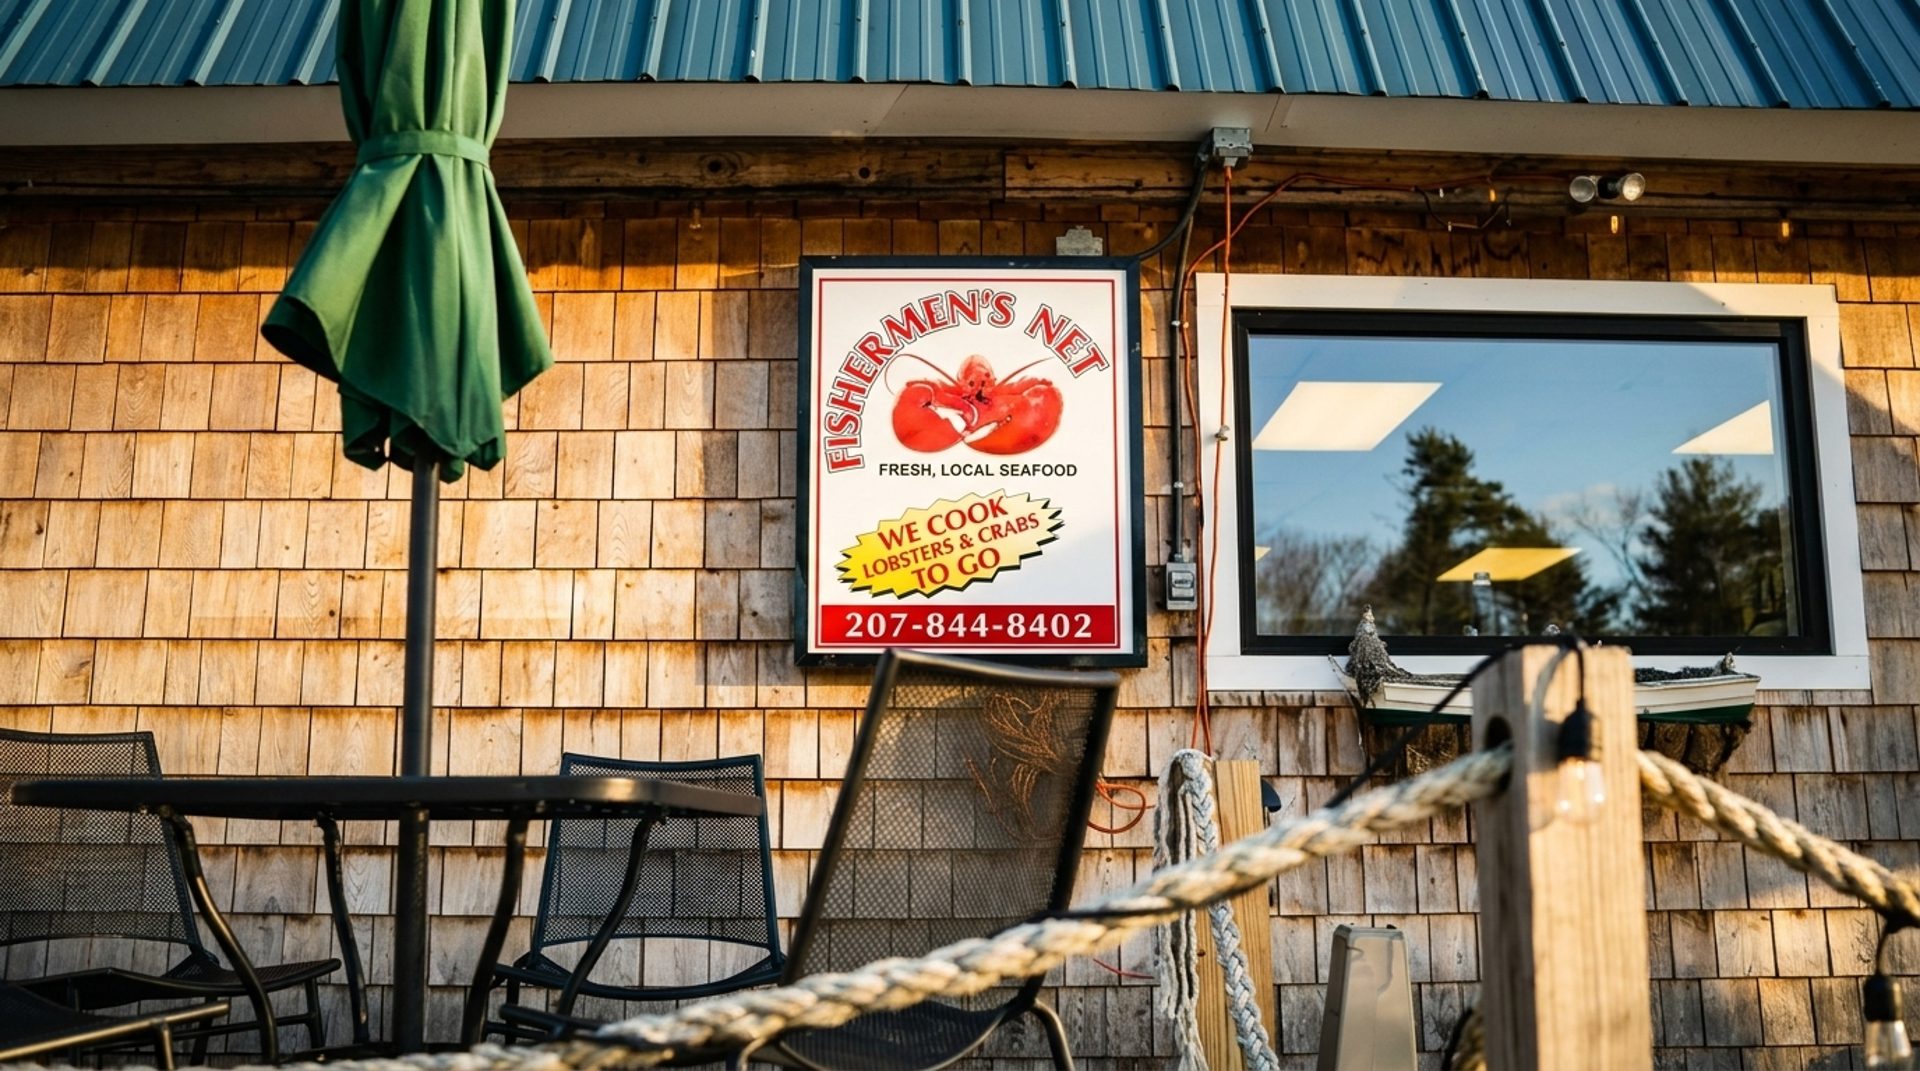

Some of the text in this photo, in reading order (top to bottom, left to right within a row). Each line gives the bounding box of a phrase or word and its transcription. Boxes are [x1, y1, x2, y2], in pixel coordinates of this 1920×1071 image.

[825, 289, 1110, 473] FISHERMEN'S NET
[879, 464, 1077, 478] FRESH, LOCAL SEAFOOD
[863, 513, 1039, 578] LOBSTERS & CRABS
[878, 496, 1009, 551] WE COOK
[911, 547, 1001, 590] TO GO
[845, 613, 1092, 639] 207-844-8402
